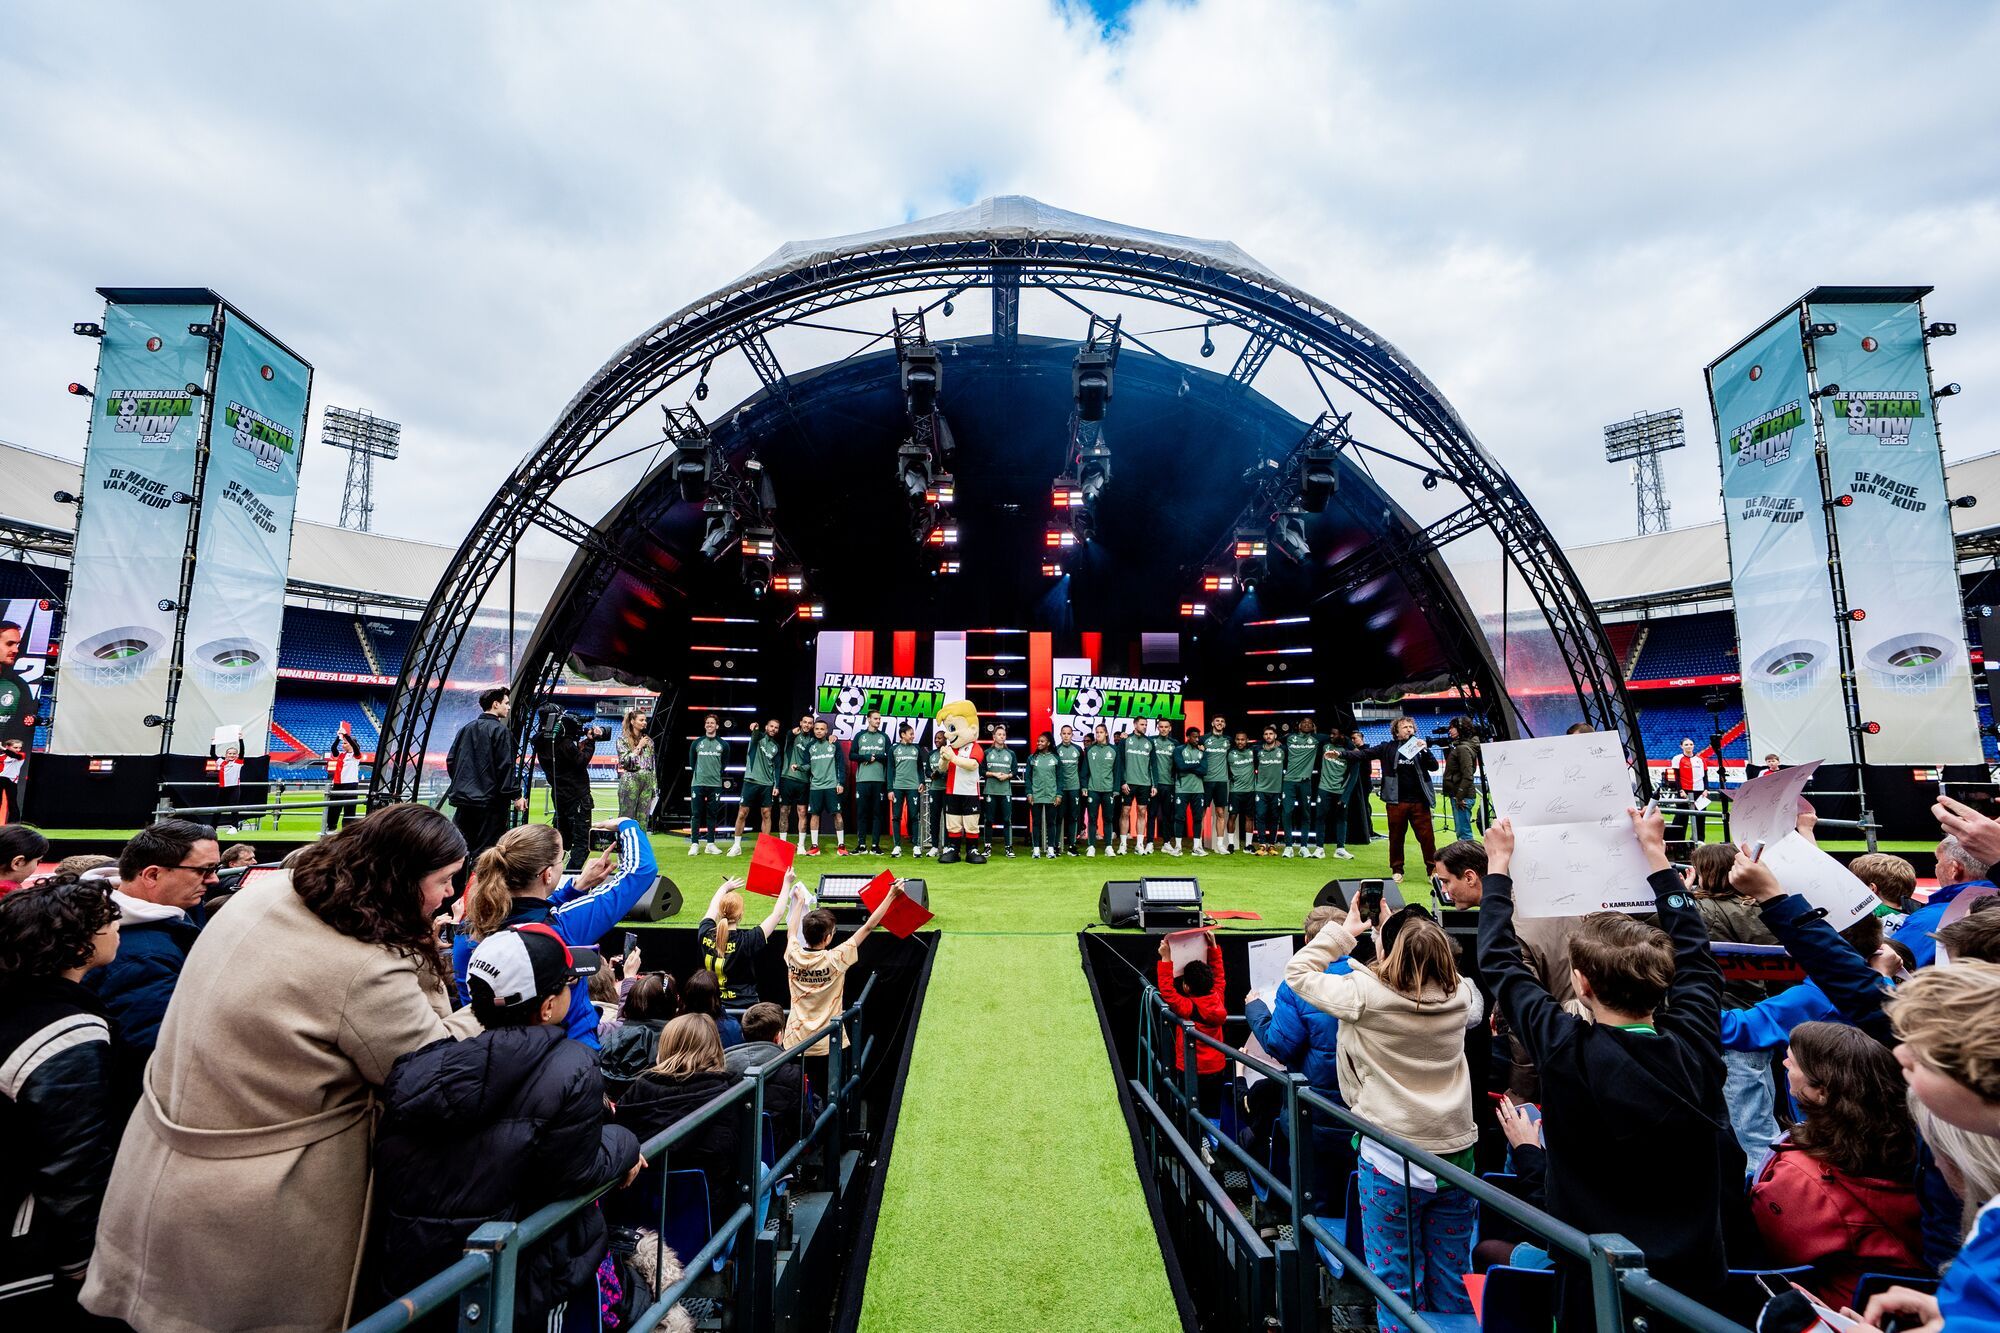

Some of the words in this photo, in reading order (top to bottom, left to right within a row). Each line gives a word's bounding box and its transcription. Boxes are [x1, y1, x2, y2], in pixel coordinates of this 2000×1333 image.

[111, 390, 124, 399] DE
[124, 390, 191, 399] KAMERAADJES
[1836, 391, 1849, 400] DE
[1849, 391, 1919, 400] KAMERAADJES
[107, 398, 193, 416] VOETBAL
[1740, 400, 1799, 432] KAMERAADJES
[1832, 399, 1925, 418] VOETBAL
[114, 416, 180, 436] SHOW
[229, 401, 242, 413] DE
[240, 406, 294, 438] KAMERAADJES
[1848, 417, 1913, 438] SHOW
[142, 432, 171, 443] 2025
[225, 407, 294, 455] VOETBAL
[1729, 407, 1806, 455] VOETBAL
[1880, 434, 1909, 445] 2025
[232, 429, 285, 464] SHOW
[1738, 428, 1794, 467] SHOW
[256, 458, 280, 473] 2025
[1765, 447, 1790, 467] 2025
[109, 468, 126, 479] DE
[124, 470, 169, 496] MAGIE
[1855, 471, 1871, 482] DE
[1871, 473, 1919, 499] MAGIE
[103, 480, 129, 491] VAN
[127, 485, 142, 497] DE
[137, 491, 172, 510] KUIP
[228, 480, 243, 493] DE
[240, 487, 275, 521] MAGIE
[1745, 497, 1758, 509] DE
[1759, 495, 1797, 510] MAGIE
[1850, 483, 1877, 494] VAN
[1878, 489, 1893, 500] DE
[1890, 495, 1927, 513] KUIP
[222, 489, 245, 506] VAN
[244, 503, 255, 515] DE
[252, 512, 277, 534] KUIP
[1742, 508, 1762, 521] VAN
[1762, 509, 1774, 518] DE
[1771, 510, 1804, 523] KUIP
[316, 671, 338, 682] UEFA
[339, 673, 356, 683] CUP
[823, 673, 844, 687] DE
[843, 674, 945, 691] KAMERAADJES
[1060, 675, 1081, 688] DE
[1080, 675, 1182, 693] KAMERAADJES
[1055, 688, 1186, 720] VOETBAL
[1609, 900, 1655, 908] KAMERAADJES
